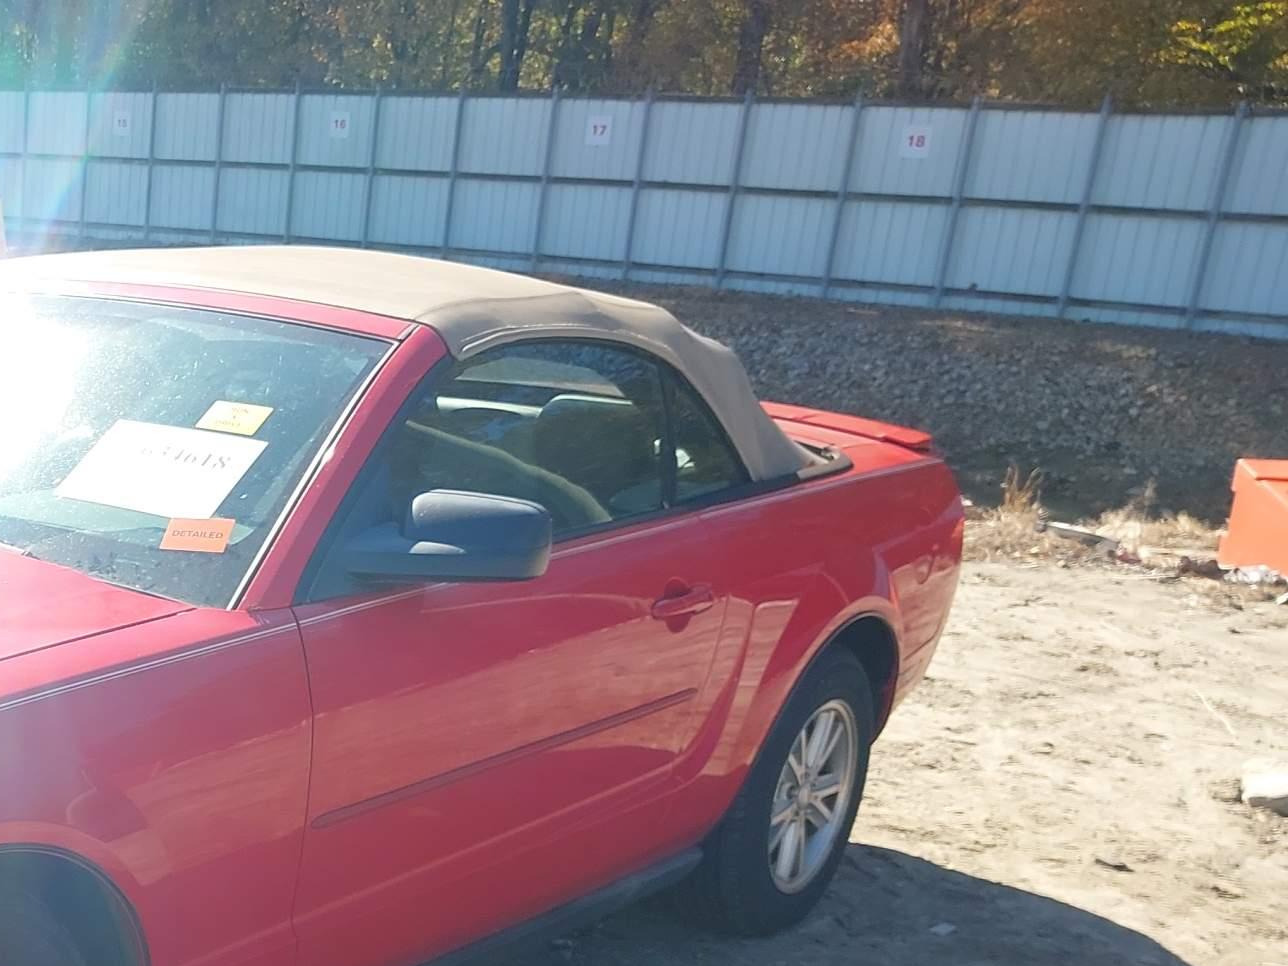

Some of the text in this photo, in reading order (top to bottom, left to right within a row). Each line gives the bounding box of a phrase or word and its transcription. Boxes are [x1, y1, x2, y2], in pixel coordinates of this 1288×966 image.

[334, 119, 347, 129] 16
[592, 124, 608, 136] 17
[908, 134, 926, 148] 18
[171, 529, 224, 540] DETAILED
